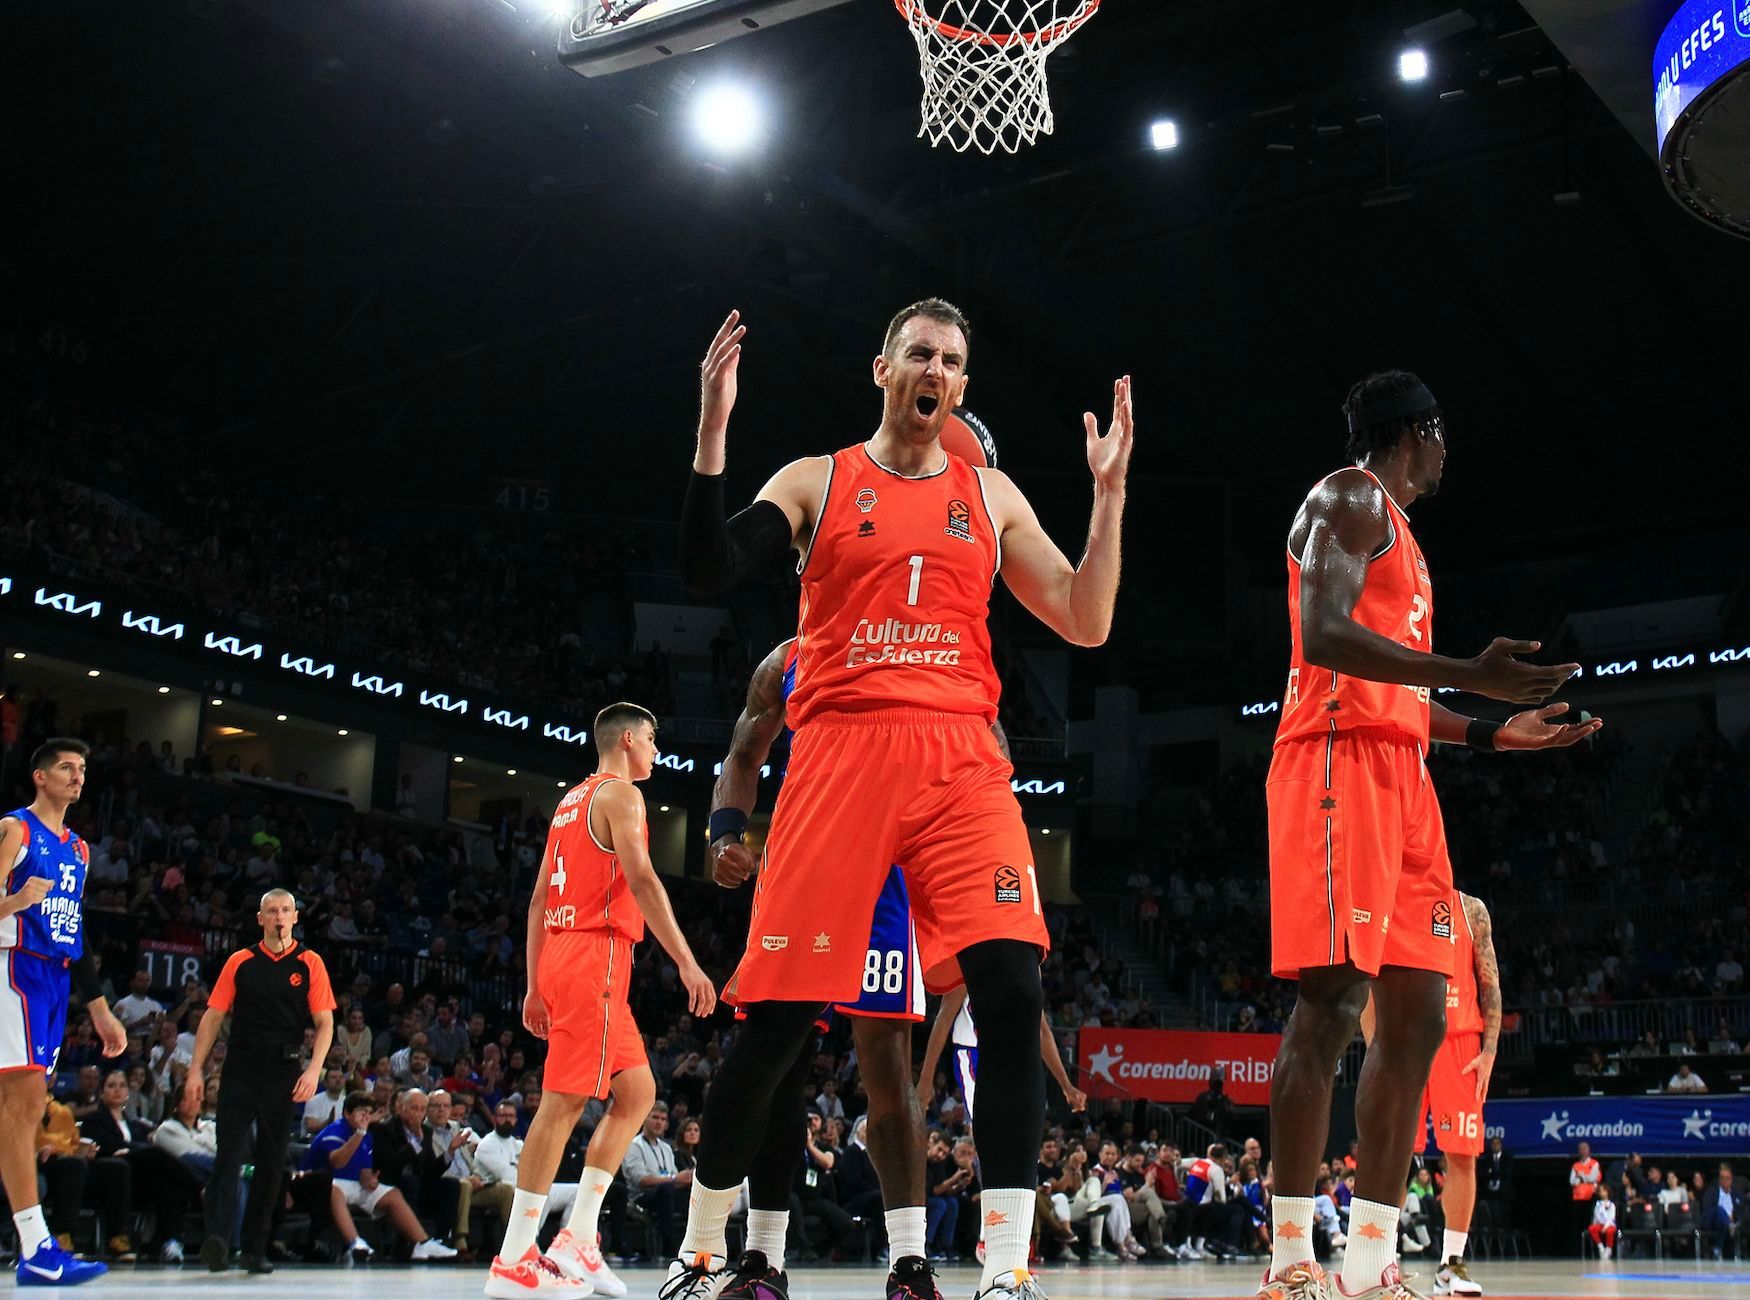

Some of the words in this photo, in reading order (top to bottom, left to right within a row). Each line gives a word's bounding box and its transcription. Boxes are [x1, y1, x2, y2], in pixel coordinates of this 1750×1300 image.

[1681, 10, 1725, 71] EFES
[494, 486, 551, 511] 415
[907, 555, 925, 606] 1
[850, 617, 942, 645] Cultura
[35, 588, 102, 617] KIA
[122, 611, 185, 639] KIA
[205, 632, 263, 659] KIA
[281, 653, 335, 679] KIA
[352, 672, 403, 697] KIA
[420, 690, 468, 714] KIA
[484, 707, 529, 730] KIA
[544, 723, 587, 745] KIA
[1011, 780, 1065, 794] KIA
[1243, 702, 1278, 715] KIA
[1596, 661, 1638, 676] KIA
[1653, 654, 1695, 669] KIA
[59, 862, 77, 893] 35
[549, 839, 567, 897] 4
[1027, 864, 1040, 916] 1
[764, 937, 787, 945] PULEVA
[144, 951, 200, 987] 118
[862, 949, 904, 994] 88
[1119, 1059, 1211, 1081] corendon
[1458, 1111, 1479, 1139] 16
[1566, 1119, 1644, 1138] corendon
[1709, 1122, 1750, 1137] core
